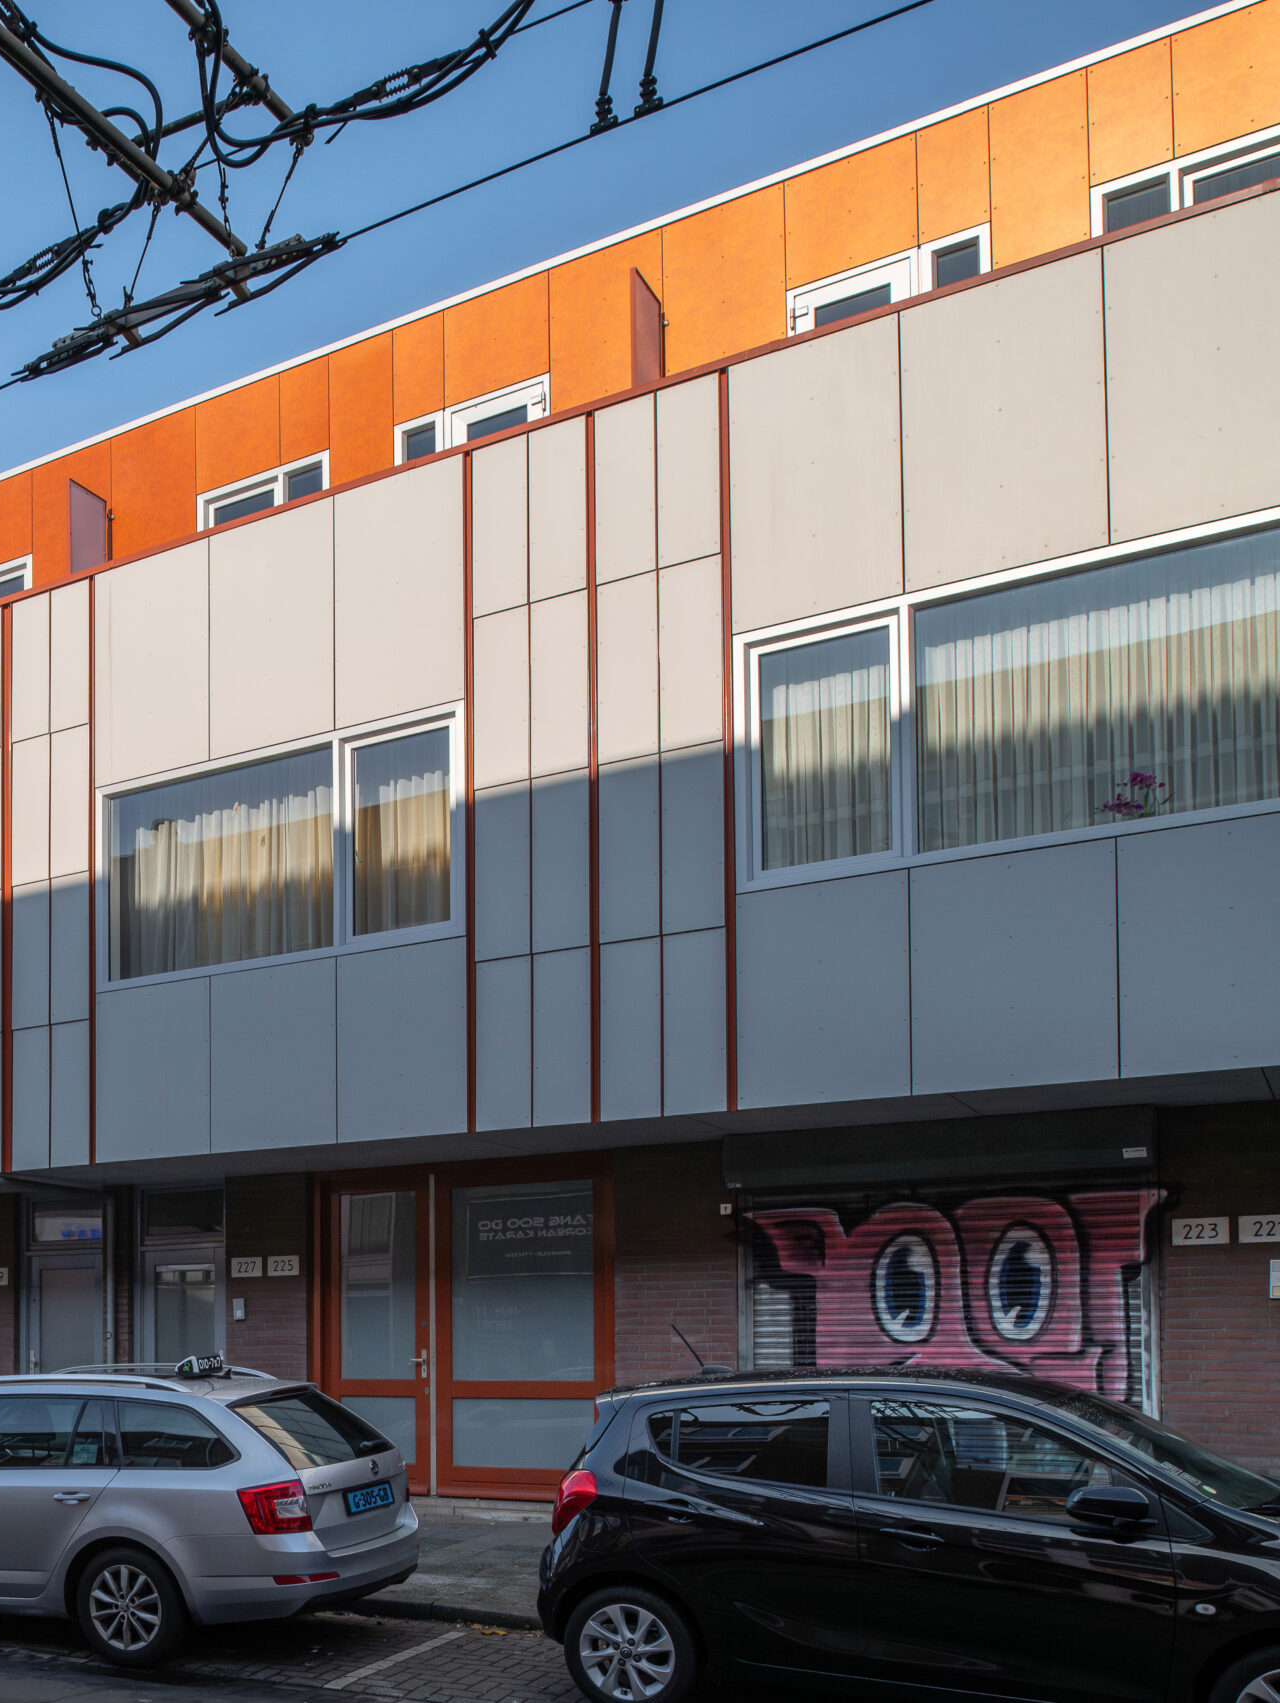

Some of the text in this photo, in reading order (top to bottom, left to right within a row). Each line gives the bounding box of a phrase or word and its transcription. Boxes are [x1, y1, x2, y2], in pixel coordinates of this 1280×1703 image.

[1182, 1223, 1219, 1240] 223
[237, 1261, 257, 1274] 227
[273, 1260, 294, 1272] 225
[352, 1487, 390, 1509] G-305-GB
